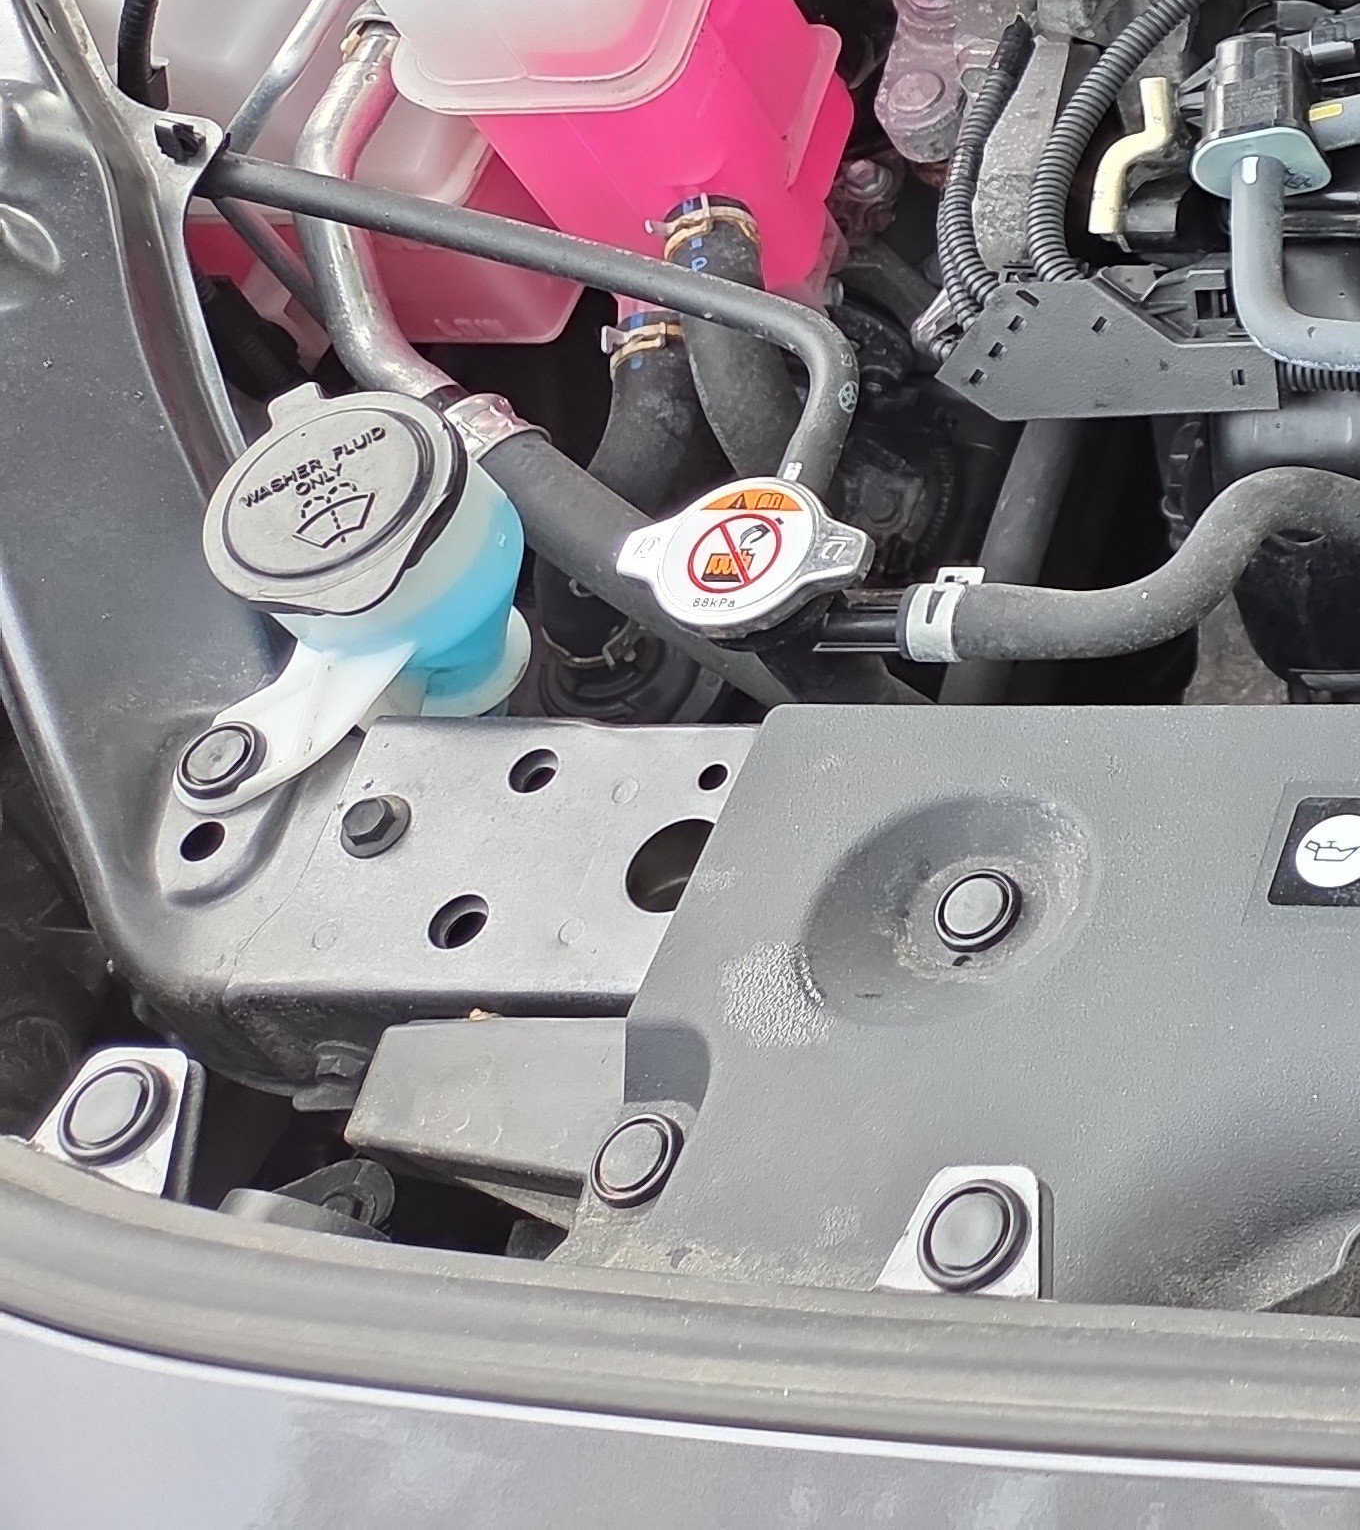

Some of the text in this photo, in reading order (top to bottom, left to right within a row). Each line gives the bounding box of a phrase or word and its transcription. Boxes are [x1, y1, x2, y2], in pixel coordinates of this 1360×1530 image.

[239, 426, 386, 508] WASHER FLUID
[295, 462, 342, 496] ONLY
[692, 597, 736, 608] 88kPa
